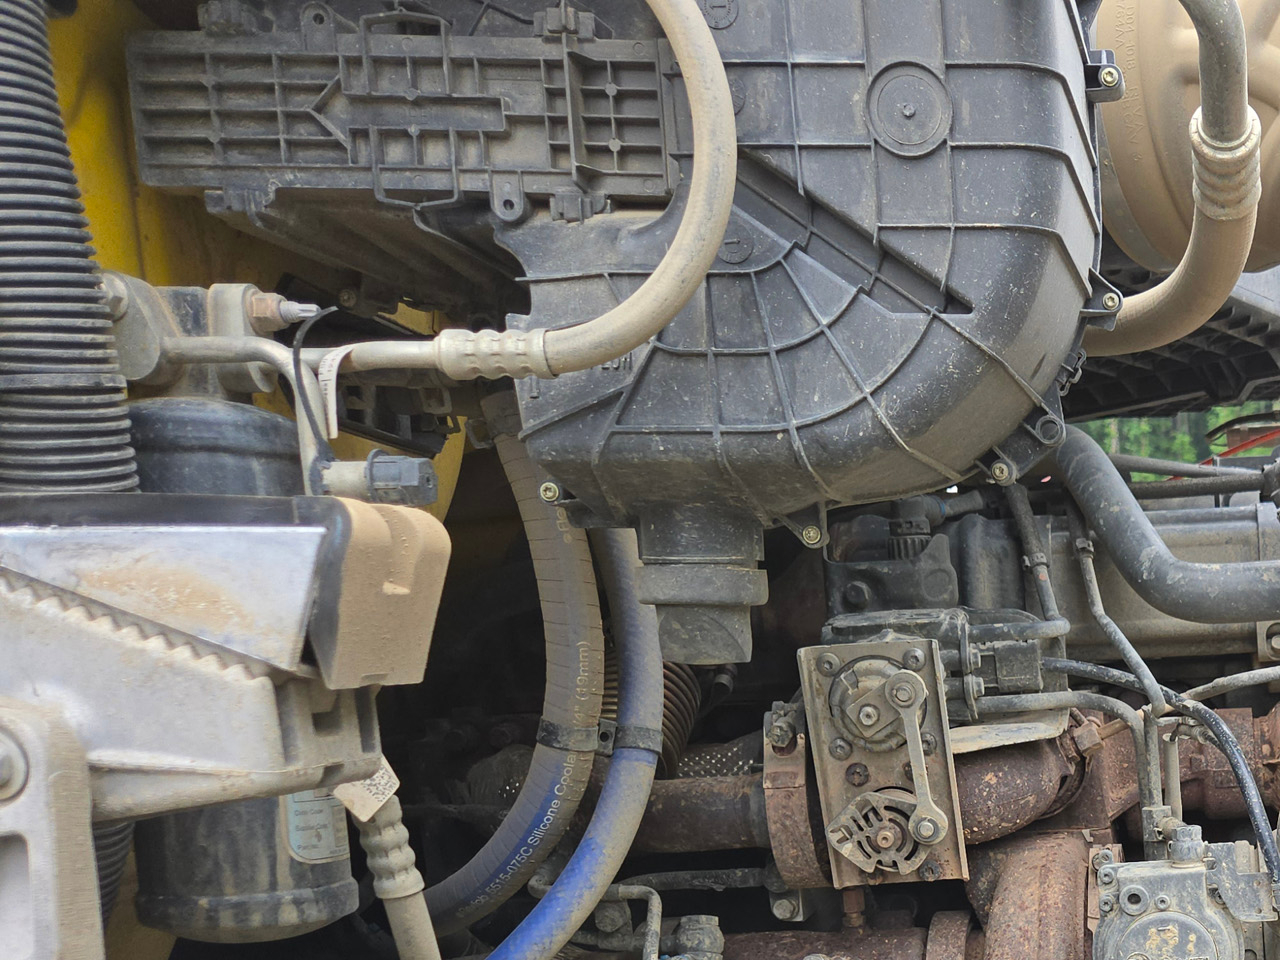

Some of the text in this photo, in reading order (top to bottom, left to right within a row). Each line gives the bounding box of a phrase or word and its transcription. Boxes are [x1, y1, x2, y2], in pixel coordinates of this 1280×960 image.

[485, 846, 533, 894] 5515-075C
[527, 798, 561, 846] Silicone
[575, 641, 591, 700] (19mm)
